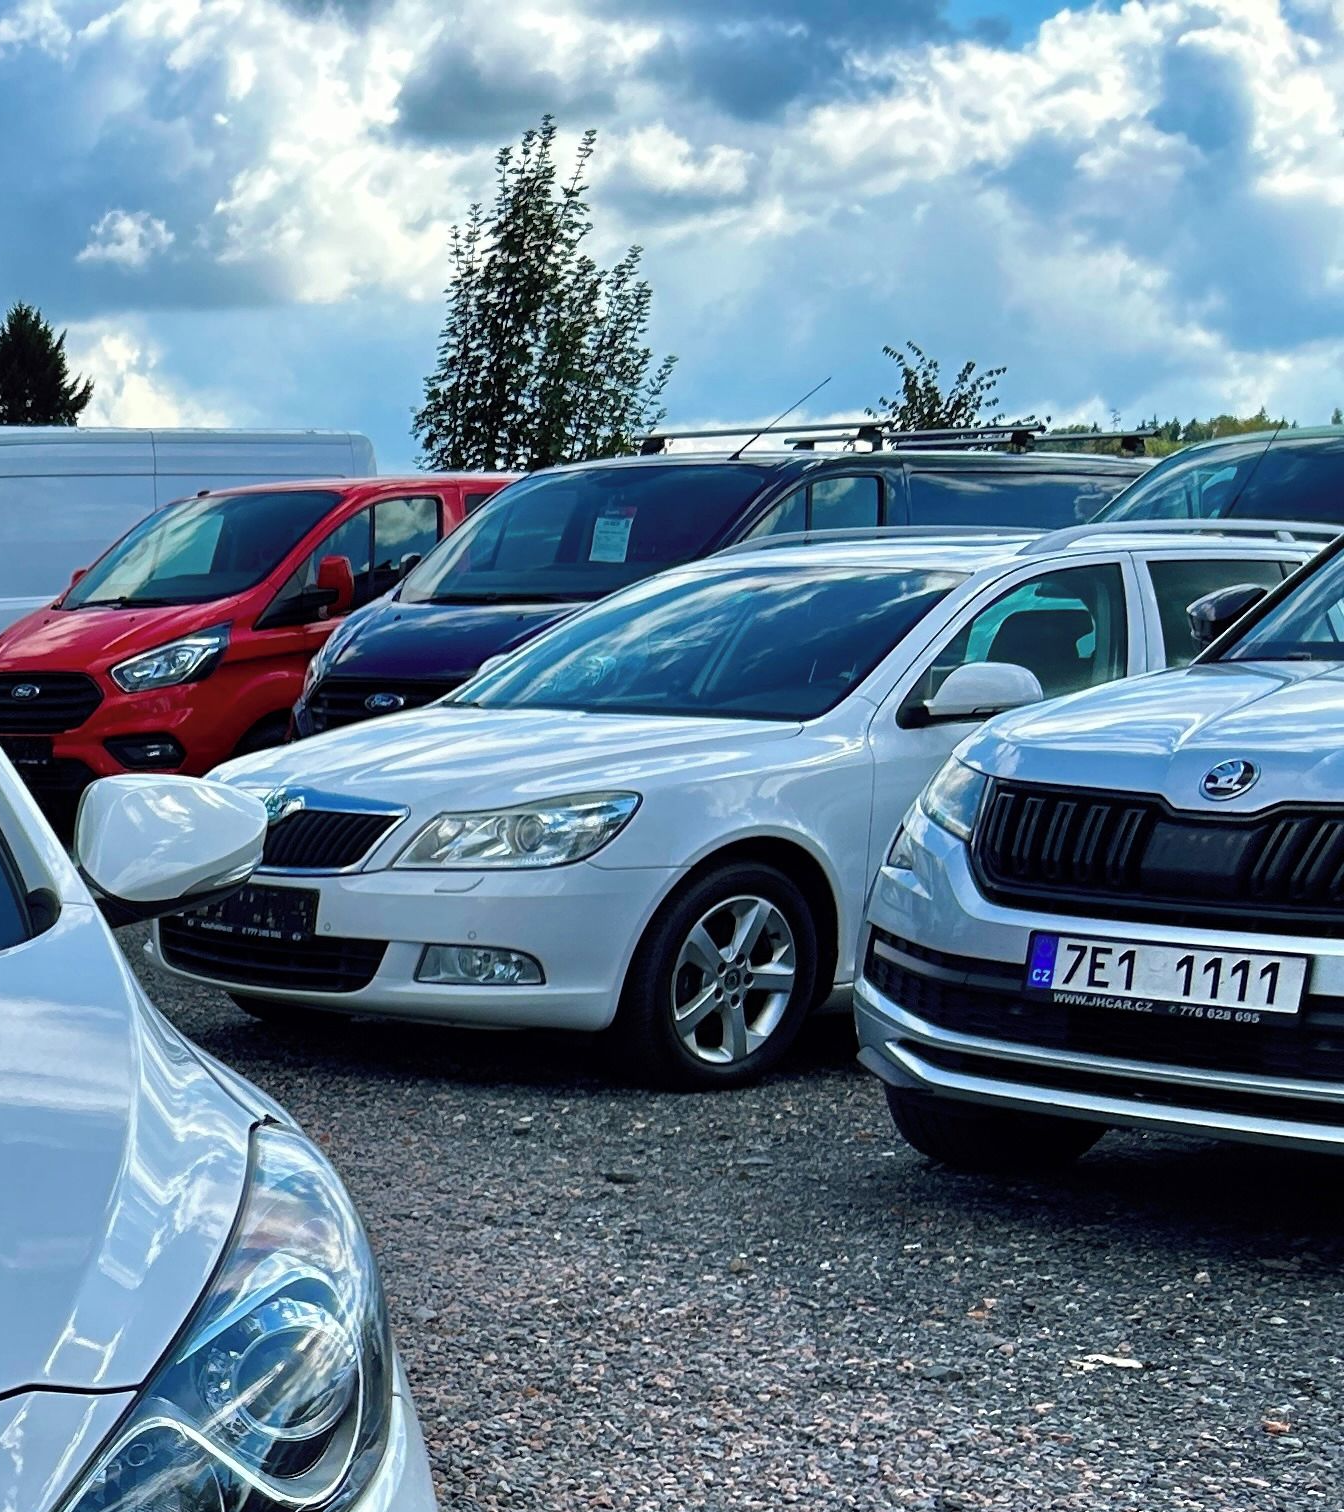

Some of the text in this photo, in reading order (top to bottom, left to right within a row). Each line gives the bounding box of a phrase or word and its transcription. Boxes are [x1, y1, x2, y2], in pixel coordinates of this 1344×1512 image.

[1032, 968, 1051, 983] CZ
[1062, 944, 1281, 1005] 7E1 1111
[1053, 991, 1153, 1012] WWW.JHCAR.CZ
[1179, 1005, 1203, 1018] 776
